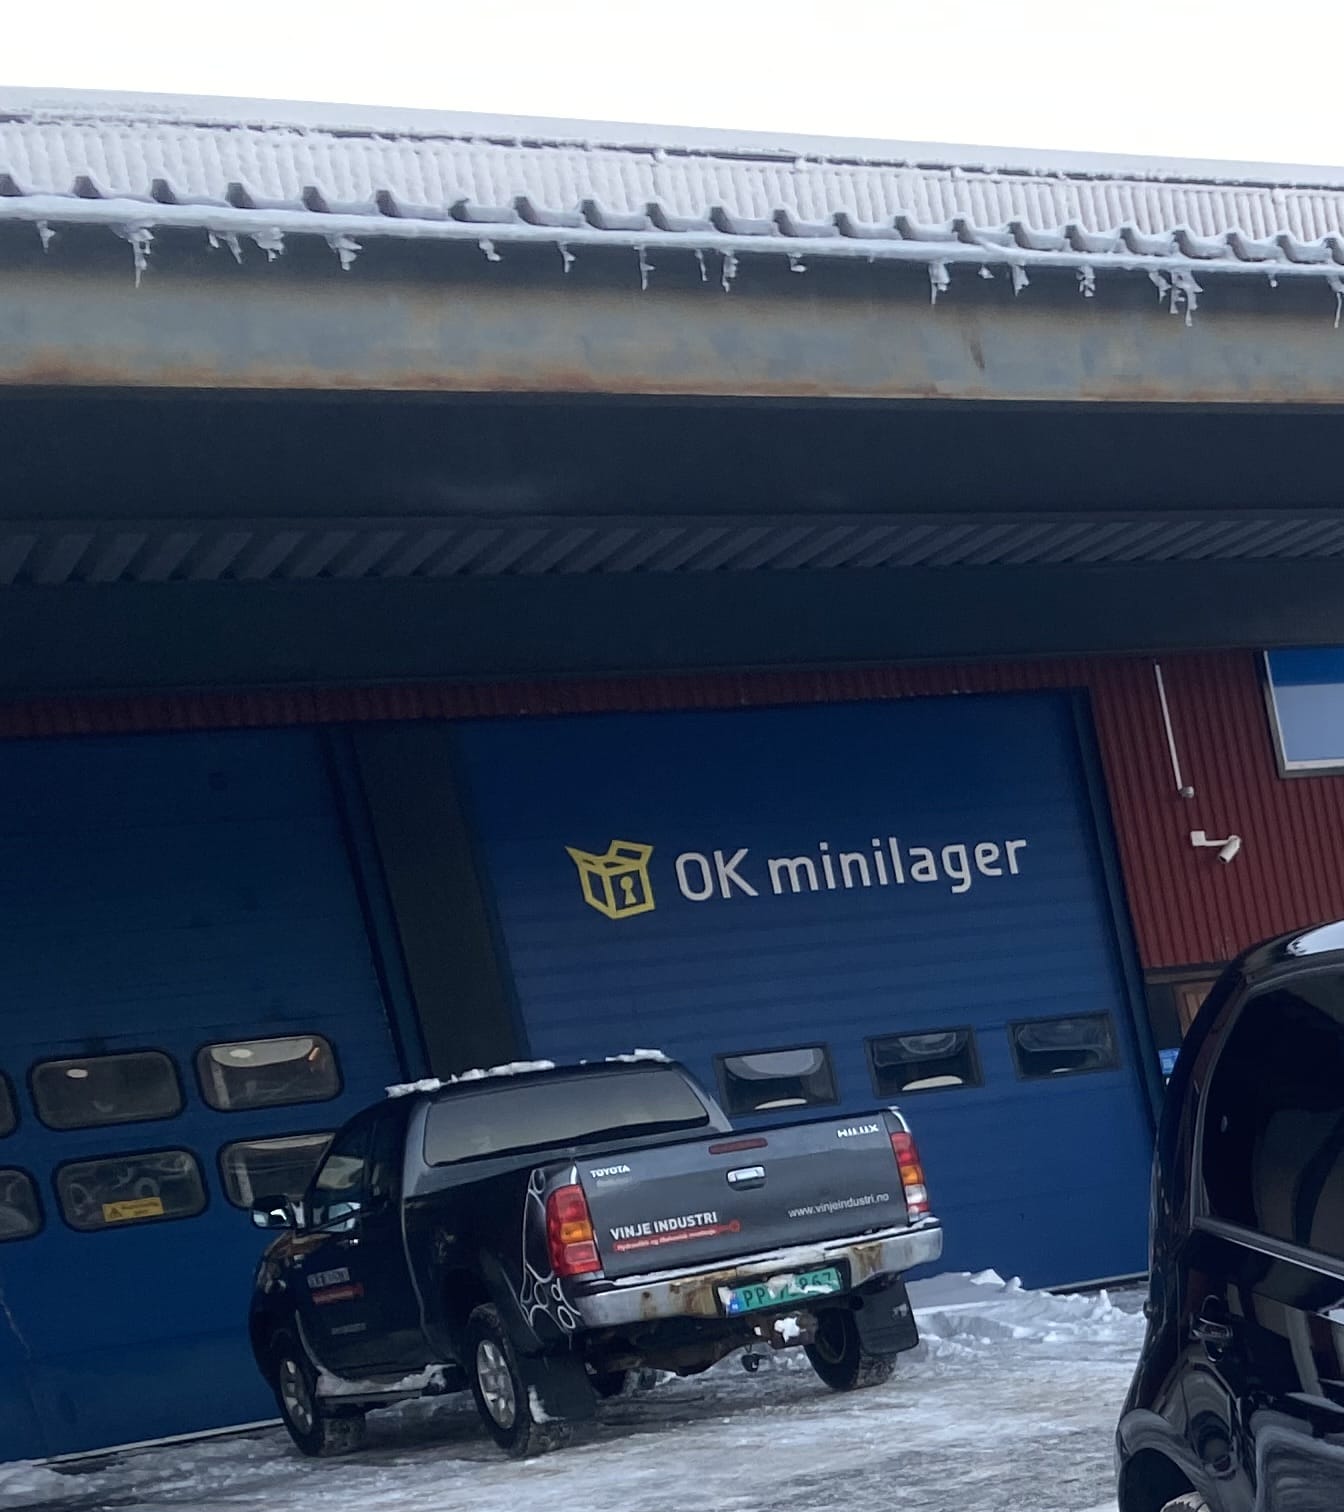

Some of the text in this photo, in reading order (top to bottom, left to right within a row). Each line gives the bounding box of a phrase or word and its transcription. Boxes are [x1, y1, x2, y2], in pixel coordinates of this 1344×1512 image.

[675, 836, 1027, 901] OK minilager
[590, 1164, 631, 1178] TOYOTA
[787, 1193, 890, 1218] www.vinjeindustri.no
[610, 1222, 652, 1241] VINJE
[653, 1211, 719, 1233] INDUSTRI
